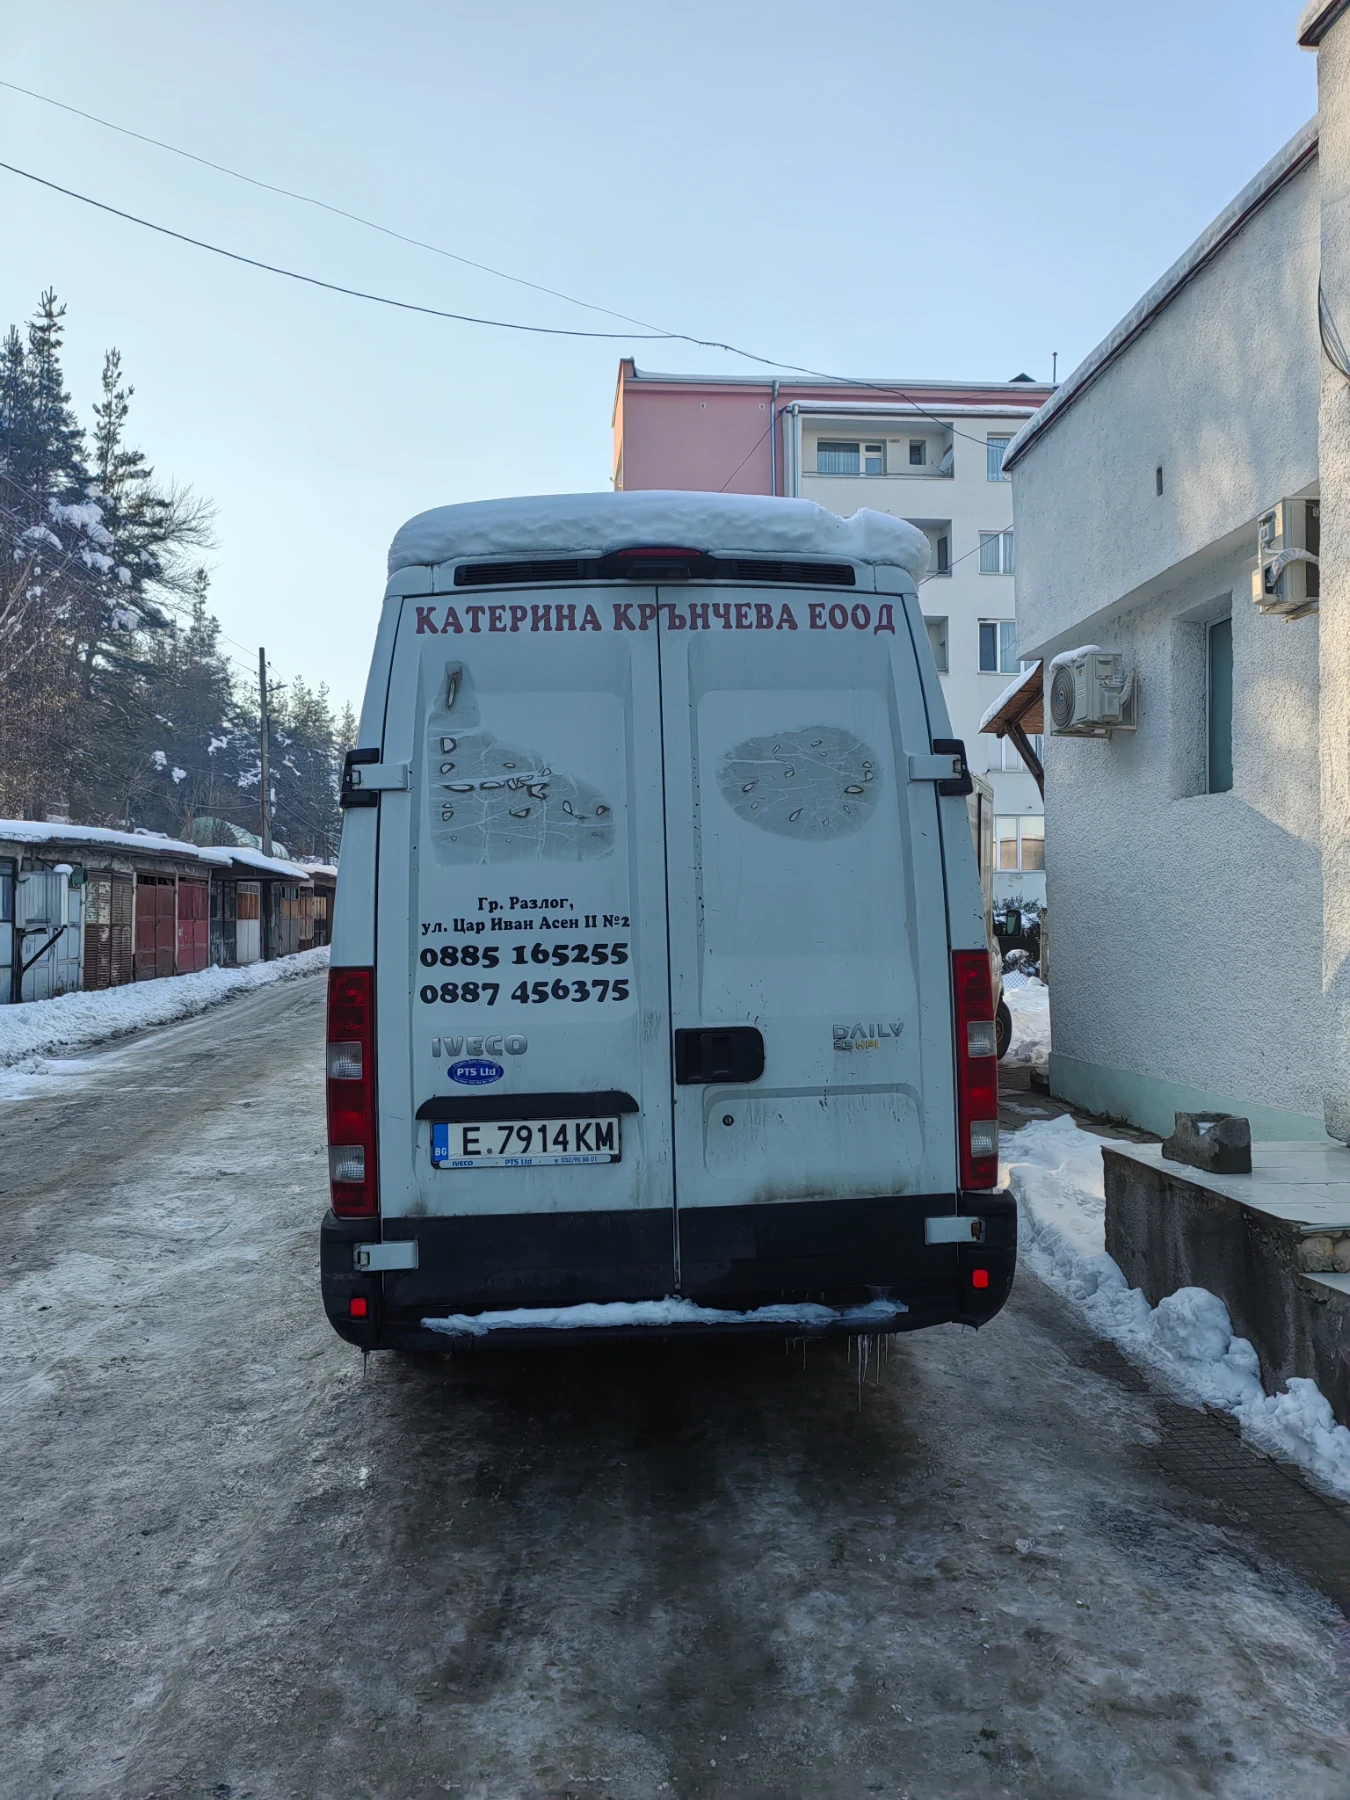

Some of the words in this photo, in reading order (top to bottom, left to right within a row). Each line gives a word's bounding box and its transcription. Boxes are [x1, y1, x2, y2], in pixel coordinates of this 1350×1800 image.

[415, 604, 603, 634] КАТЕРИНА
[612, 602, 799, 631] КРЪНЧЕВА
[808, 602, 896, 636] ЕООД
[477, 897, 504, 913] Гр.
[508, 896, 574, 911] Разлог,
[421, 922, 448, 935] ул.
[452, 918, 486, 935] Цар
[490, 917, 534, 931] Иван
[538, 916, 579, 930] Асен
[419, 945, 500, 969] 0885
[511, 942, 629, 967] 165255
[419, 981, 500, 1006] 0887
[511, 978, 630, 1004] 456375
[832, 1022, 904, 1040] DAILY
[431, 1034, 529, 1058] IVECO
[456, 1067, 477, 1076] PTS
[480, 1065, 497, 1076] Ltd
[434, 1147, 448, 1157] BG
[452, 1160, 474, 1168] IVECO
